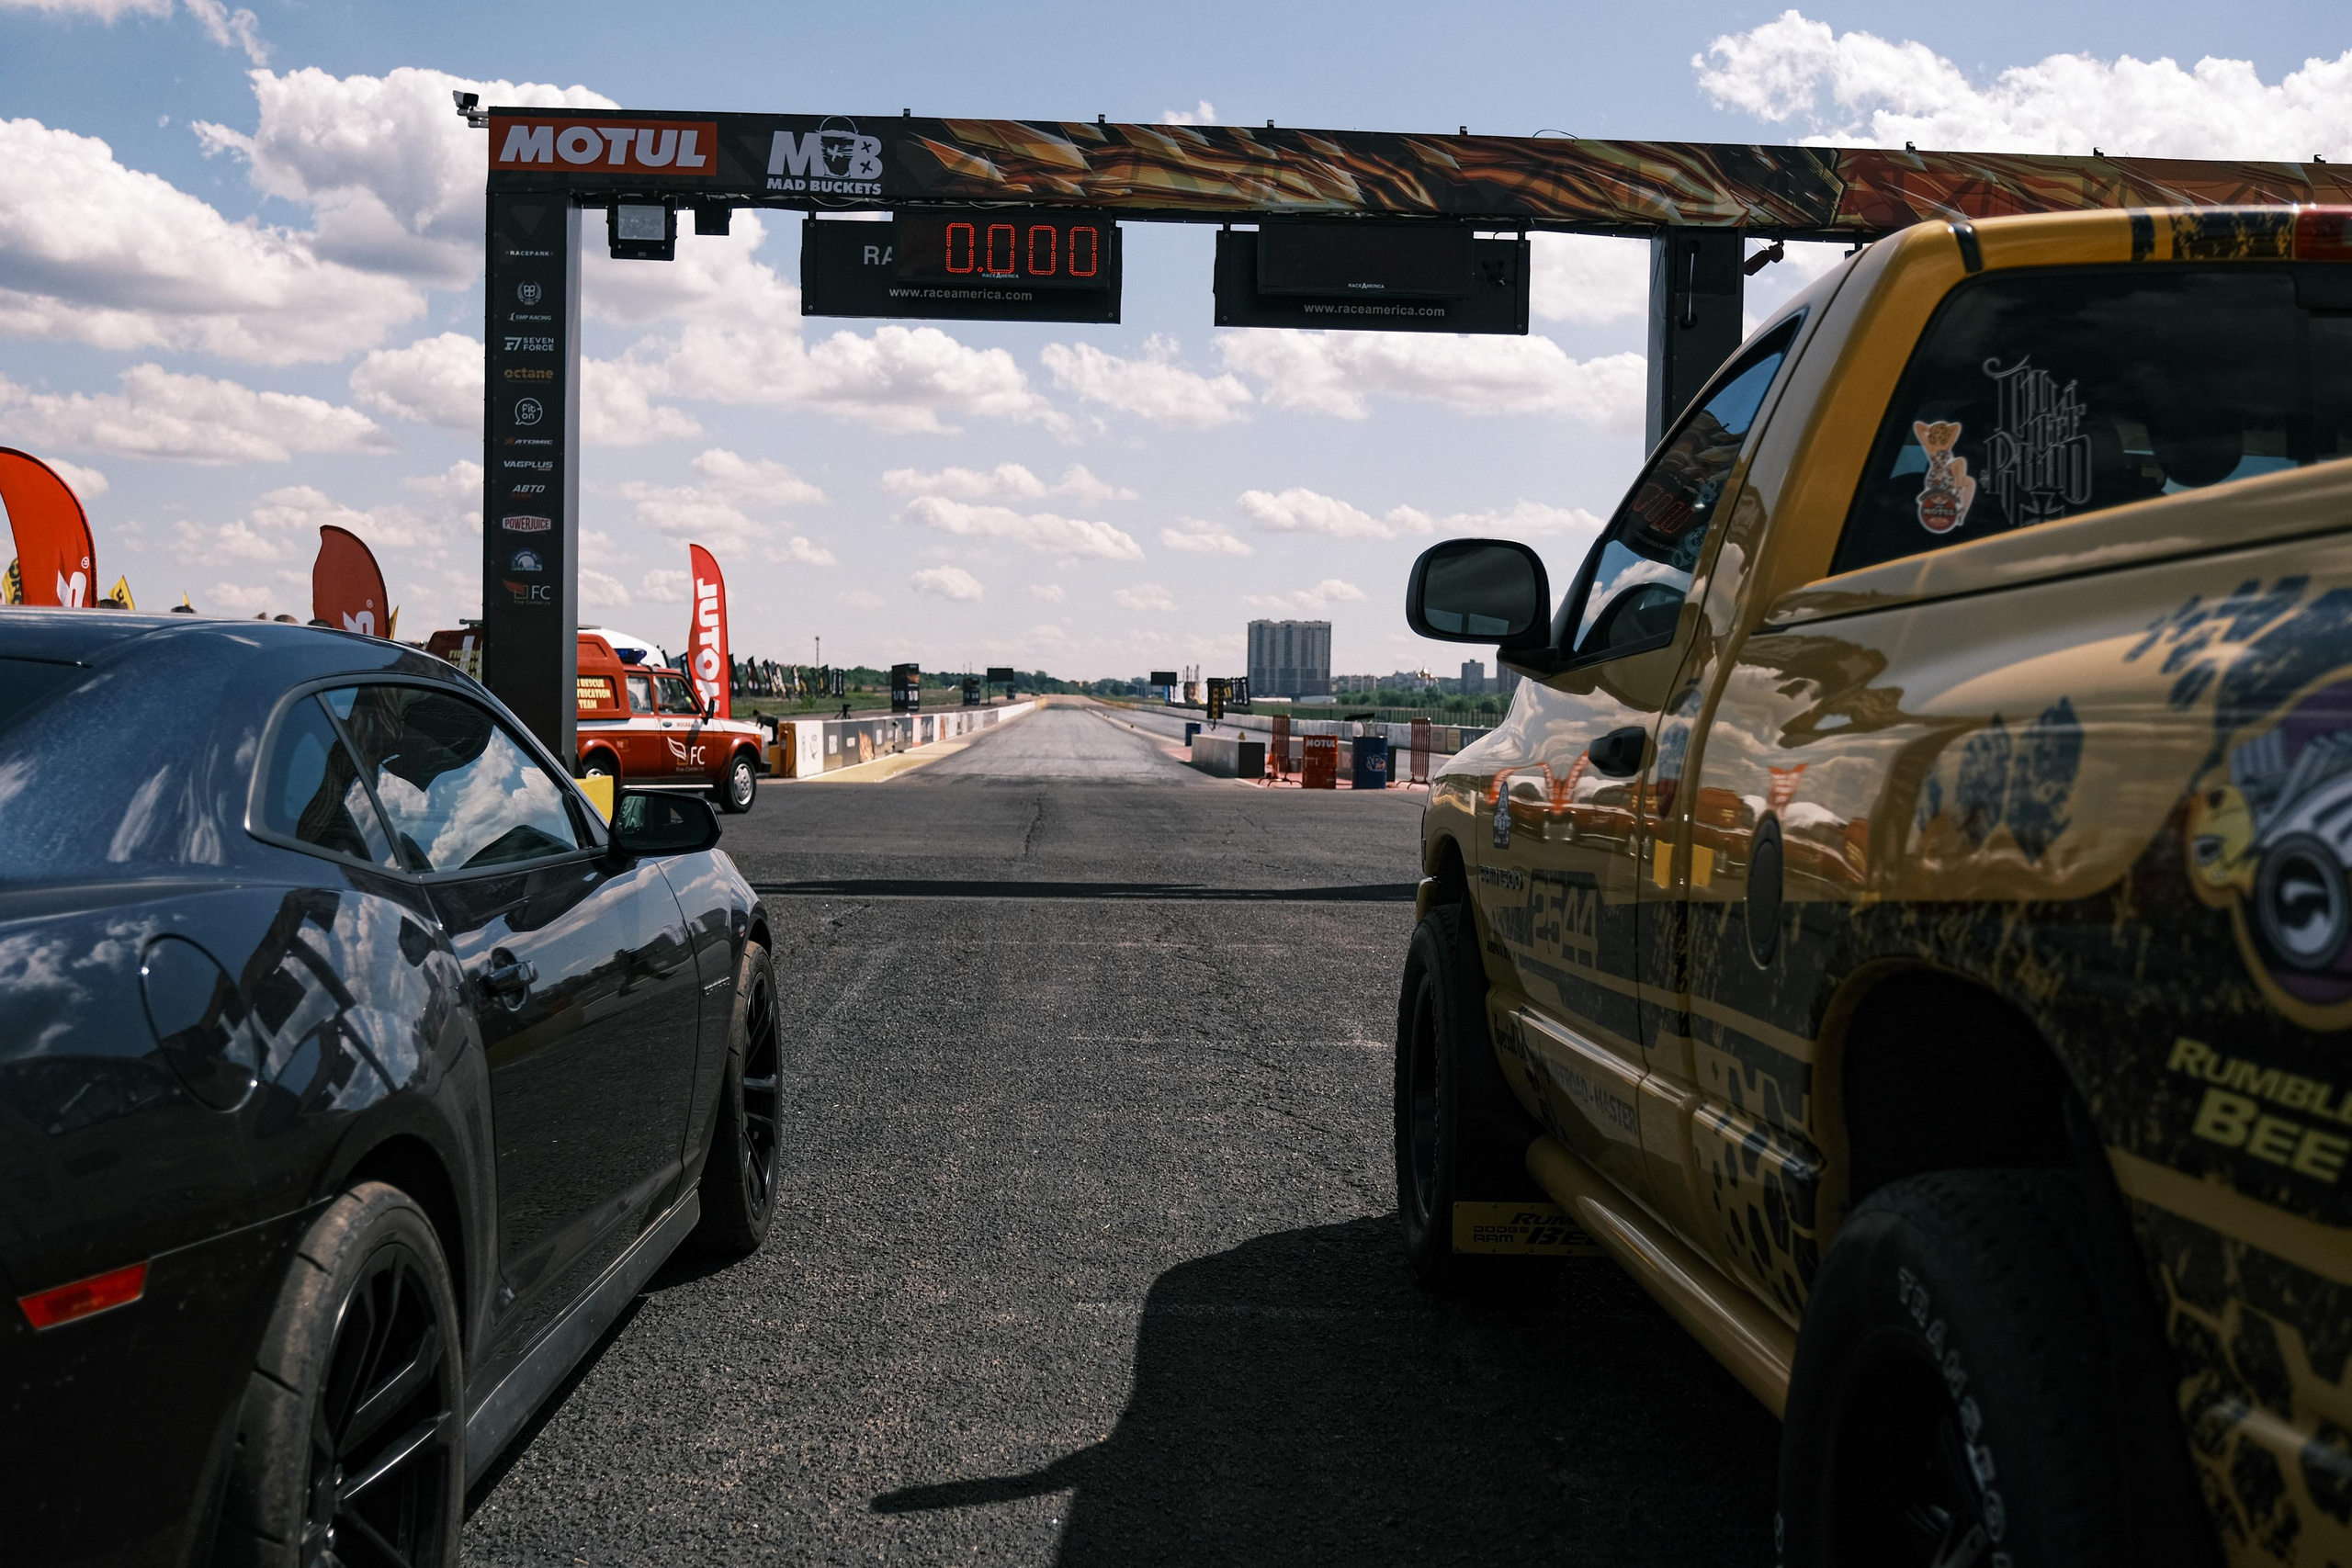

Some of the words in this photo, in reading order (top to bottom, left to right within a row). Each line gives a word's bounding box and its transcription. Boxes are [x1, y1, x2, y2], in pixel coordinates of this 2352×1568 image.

[499, 125, 707, 168] MOTUL
[766, 178, 806, 191] MAD
[809, 180, 881, 195] BUCKETS
[945, 222, 1098, 276] 0.000
[889, 287, 1033, 301] www.raceamerica.com
[1304, 303, 1445, 317] www.raceamerica.com
[503, 367, 554, 379] octane
[503, 460, 553, 468] VAGPLUS
[504, 517, 549, 530] POWERJUICE
[531, 584, 551, 600] FC
[695, 578, 720, 713] MOTUL
[578, 699, 597, 709] TEAM
[1306, 739, 1335, 748] MOTUL
[690, 746, 706, 765] FC
[1532, 880, 1599, 970] 2544
[2190, 1086, 2352, 1184] BEE
[1473, 1225, 1529, 1234] DODGE
[1473, 1234, 1513, 1243] RAM
